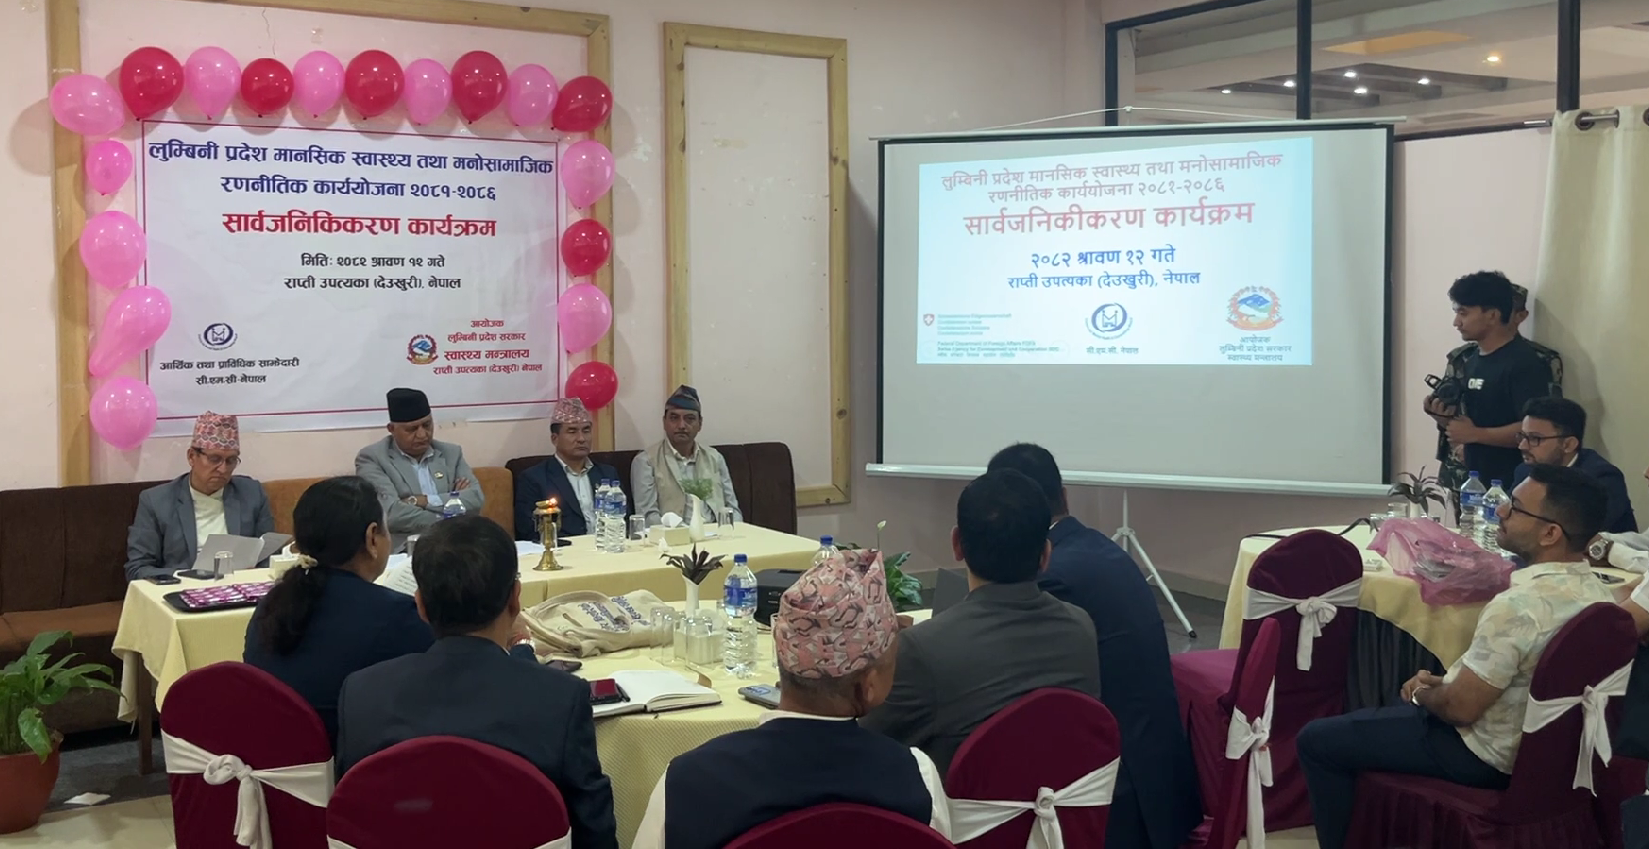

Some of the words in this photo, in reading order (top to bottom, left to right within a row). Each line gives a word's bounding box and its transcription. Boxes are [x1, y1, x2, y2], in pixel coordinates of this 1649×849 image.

[149, 139, 219, 162] लुम्बिनी
[225, 143, 268, 161] प्रदेश
[274, 145, 346, 164] मानसिक
[352, 152, 411, 167] स्वास्थ्य
[417, 155, 448, 169] तथा
[453, 153, 554, 174] मनोसामाजिक
[941, 169, 988, 191] लुम्बिनी
[991, 168, 1025, 186] प्रदेश
[1028, 163, 1088, 182] मानसिक
[1092, 163, 1141, 178] स्वास्थ्य
[1145, 161, 1174, 176] तथा
[1178, 150, 1283, 174] मनोसामाजिक
[221, 174, 308, 194] रणनीतिक
[314, 177, 405, 196] कार्ययोजना
[410, 183, 496, 200] २०८१-२०८६
[988, 184, 1054, 203] रणनीतिक
[1057, 180, 1134, 199] कार्ययोजना
[1138, 177, 1225, 196] २०८१-२०८६
[223, 209, 400, 235] सार्वजनिकिकरण
[408, 214, 497, 237] कार्यक्रम
[963, 203, 1146, 235] सार्वजनिकीकरण
[1153, 196, 1256, 227] कार्यक्रम
[337, 256, 367, 267] २०८२
[371, 256, 405, 267] श्रावण
[408, 257, 423, 267] १२
[427, 254, 445, 267] गते
[1031, 252, 1071, 268] २०८२
[1077, 250, 1122, 265] श्रावण
[1126, 249, 1145, 265] १२
[1151, 244, 1176, 263] गते
[284, 275, 315, 289] राप्ती
[319, 277, 369, 289] उपत्यका
[428, 275, 461, 289] नेपाल
[1007, 272, 1038, 288] राप्ती
[1041, 275, 1093, 288] उपत्यका
[1098, 269, 1158, 289] (देउखुरी),
[1163, 269, 1201, 285] नेपाल
[471, 318, 504, 328] आयोजक
[447, 332, 477, 343] लुम्बिनी
[479, 332, 497, 341] प्रदेश
[499, 332, 526, 341] सरकार
[196, 360, 215, 369] तथा
[444, 350, 482, 361] स्वास्थ्य
[485, 349, 530, 360] मन्त्रालय
[522, 363, 543, 372] नेपाल
